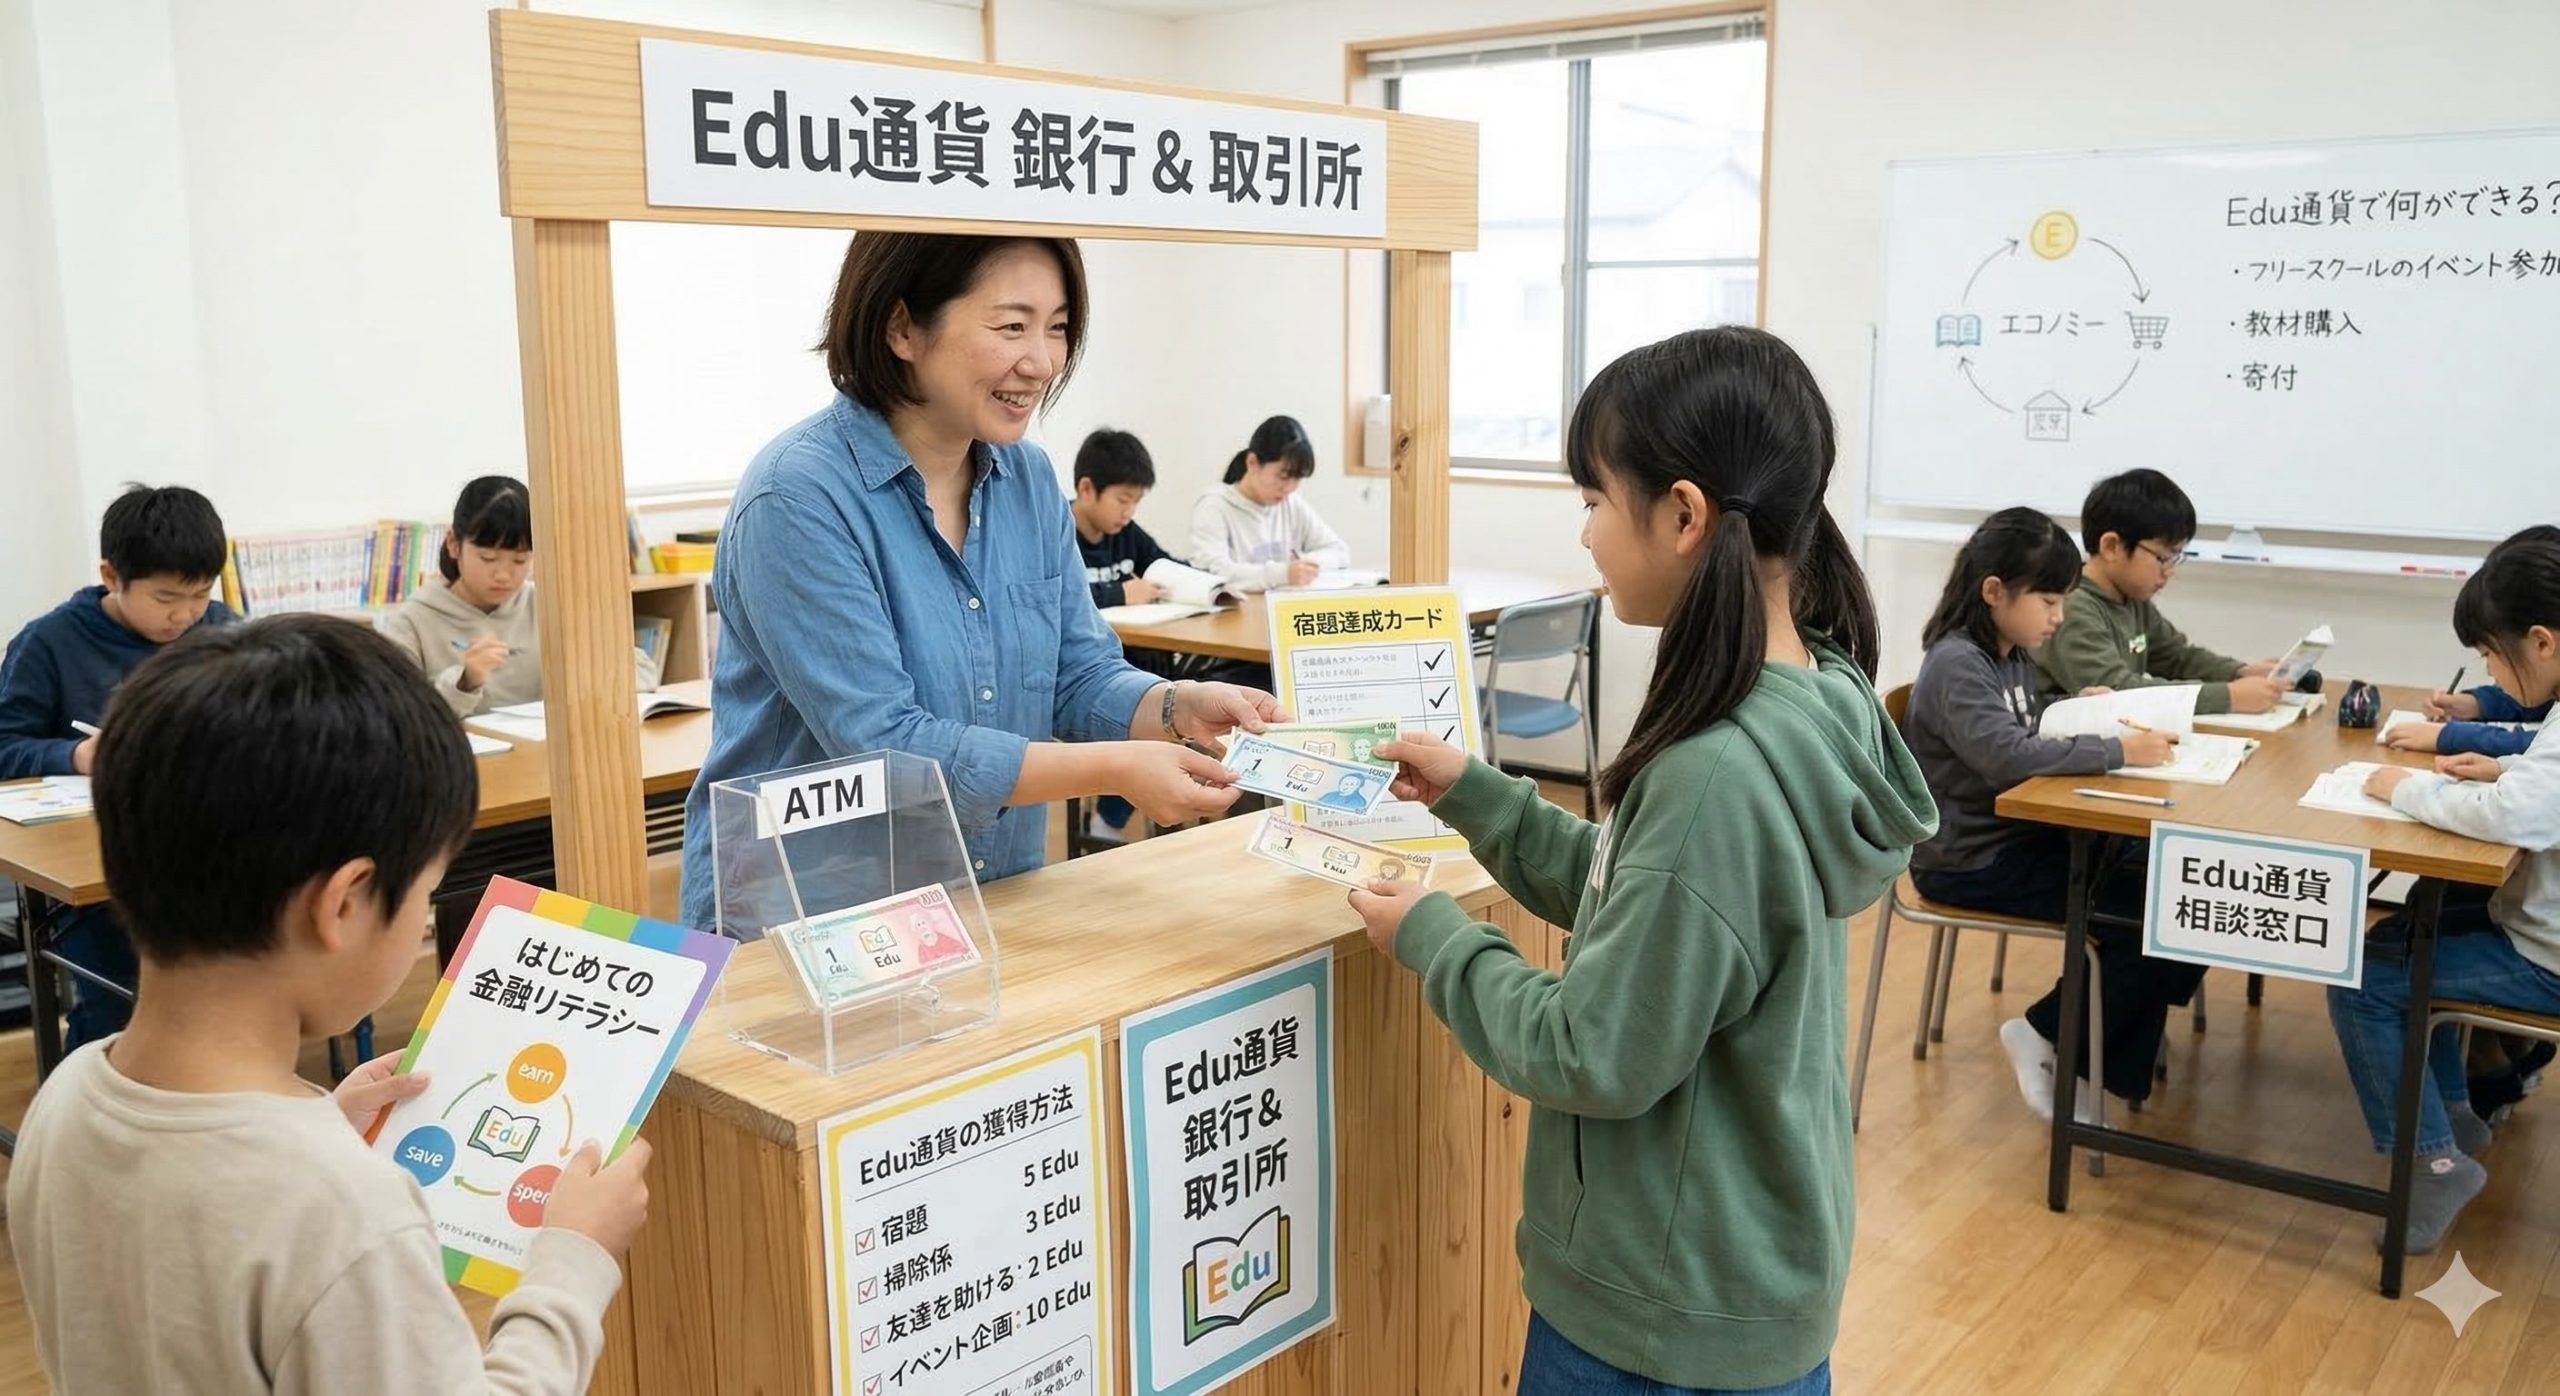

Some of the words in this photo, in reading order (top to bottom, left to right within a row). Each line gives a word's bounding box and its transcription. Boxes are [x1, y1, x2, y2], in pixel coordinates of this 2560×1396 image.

[692, 88, 990, 190] Edu通貨
[1012, 107, 1137, 197] 銀行
[1152, 129, 1194, 195] &
[1208, 130, 1363, 211] 取引所
[1999, 311, 2106, 337] エコノミー
[1293, 608, 1443, 637] 宿題達成カード
[1251, 758, 1263, 771] 1
[783, 774, 864, 824] ATM
[1284, 837, 1294, 849] 1
[2181, 856, 2331, 906] Edu通貨
[2175, 895, 2328, 948] 相談窓口
[516, 937, 654, 998] はじめての
[825, 947, 837, 963] 1
[874, 953, 901, 969] Edu
[469, 968, 661, 1038] 金融リテラシー
[518, 1062, 555, 1085] earn
[1164, 1014, 1300, 1106] Edu通貨
[406, 1144, 444, 1168] save
[485, 1119, 526, 1148] Edu
[859, 1083, 1074, 1186] Edu通貨の獲得方法
[881, 1203, 930, 1249] 宿題
[1023, 1165, 1036, 1188] 5
[1042, 1149, 1079, 1181] Edu
[1183, 1137, 1289, 1222] 取引所
[884, 1243, 953, 1297] 掃除係
[1026, 1210, 1038, 1233] 3
[1044, 1193, 1081, 1227] Edu
[1046, 1237, 1083, 1271] Edu
[1054, 1280, 1092, 1312] Edu
[1206, 1248, 1272, 1305] Edu
